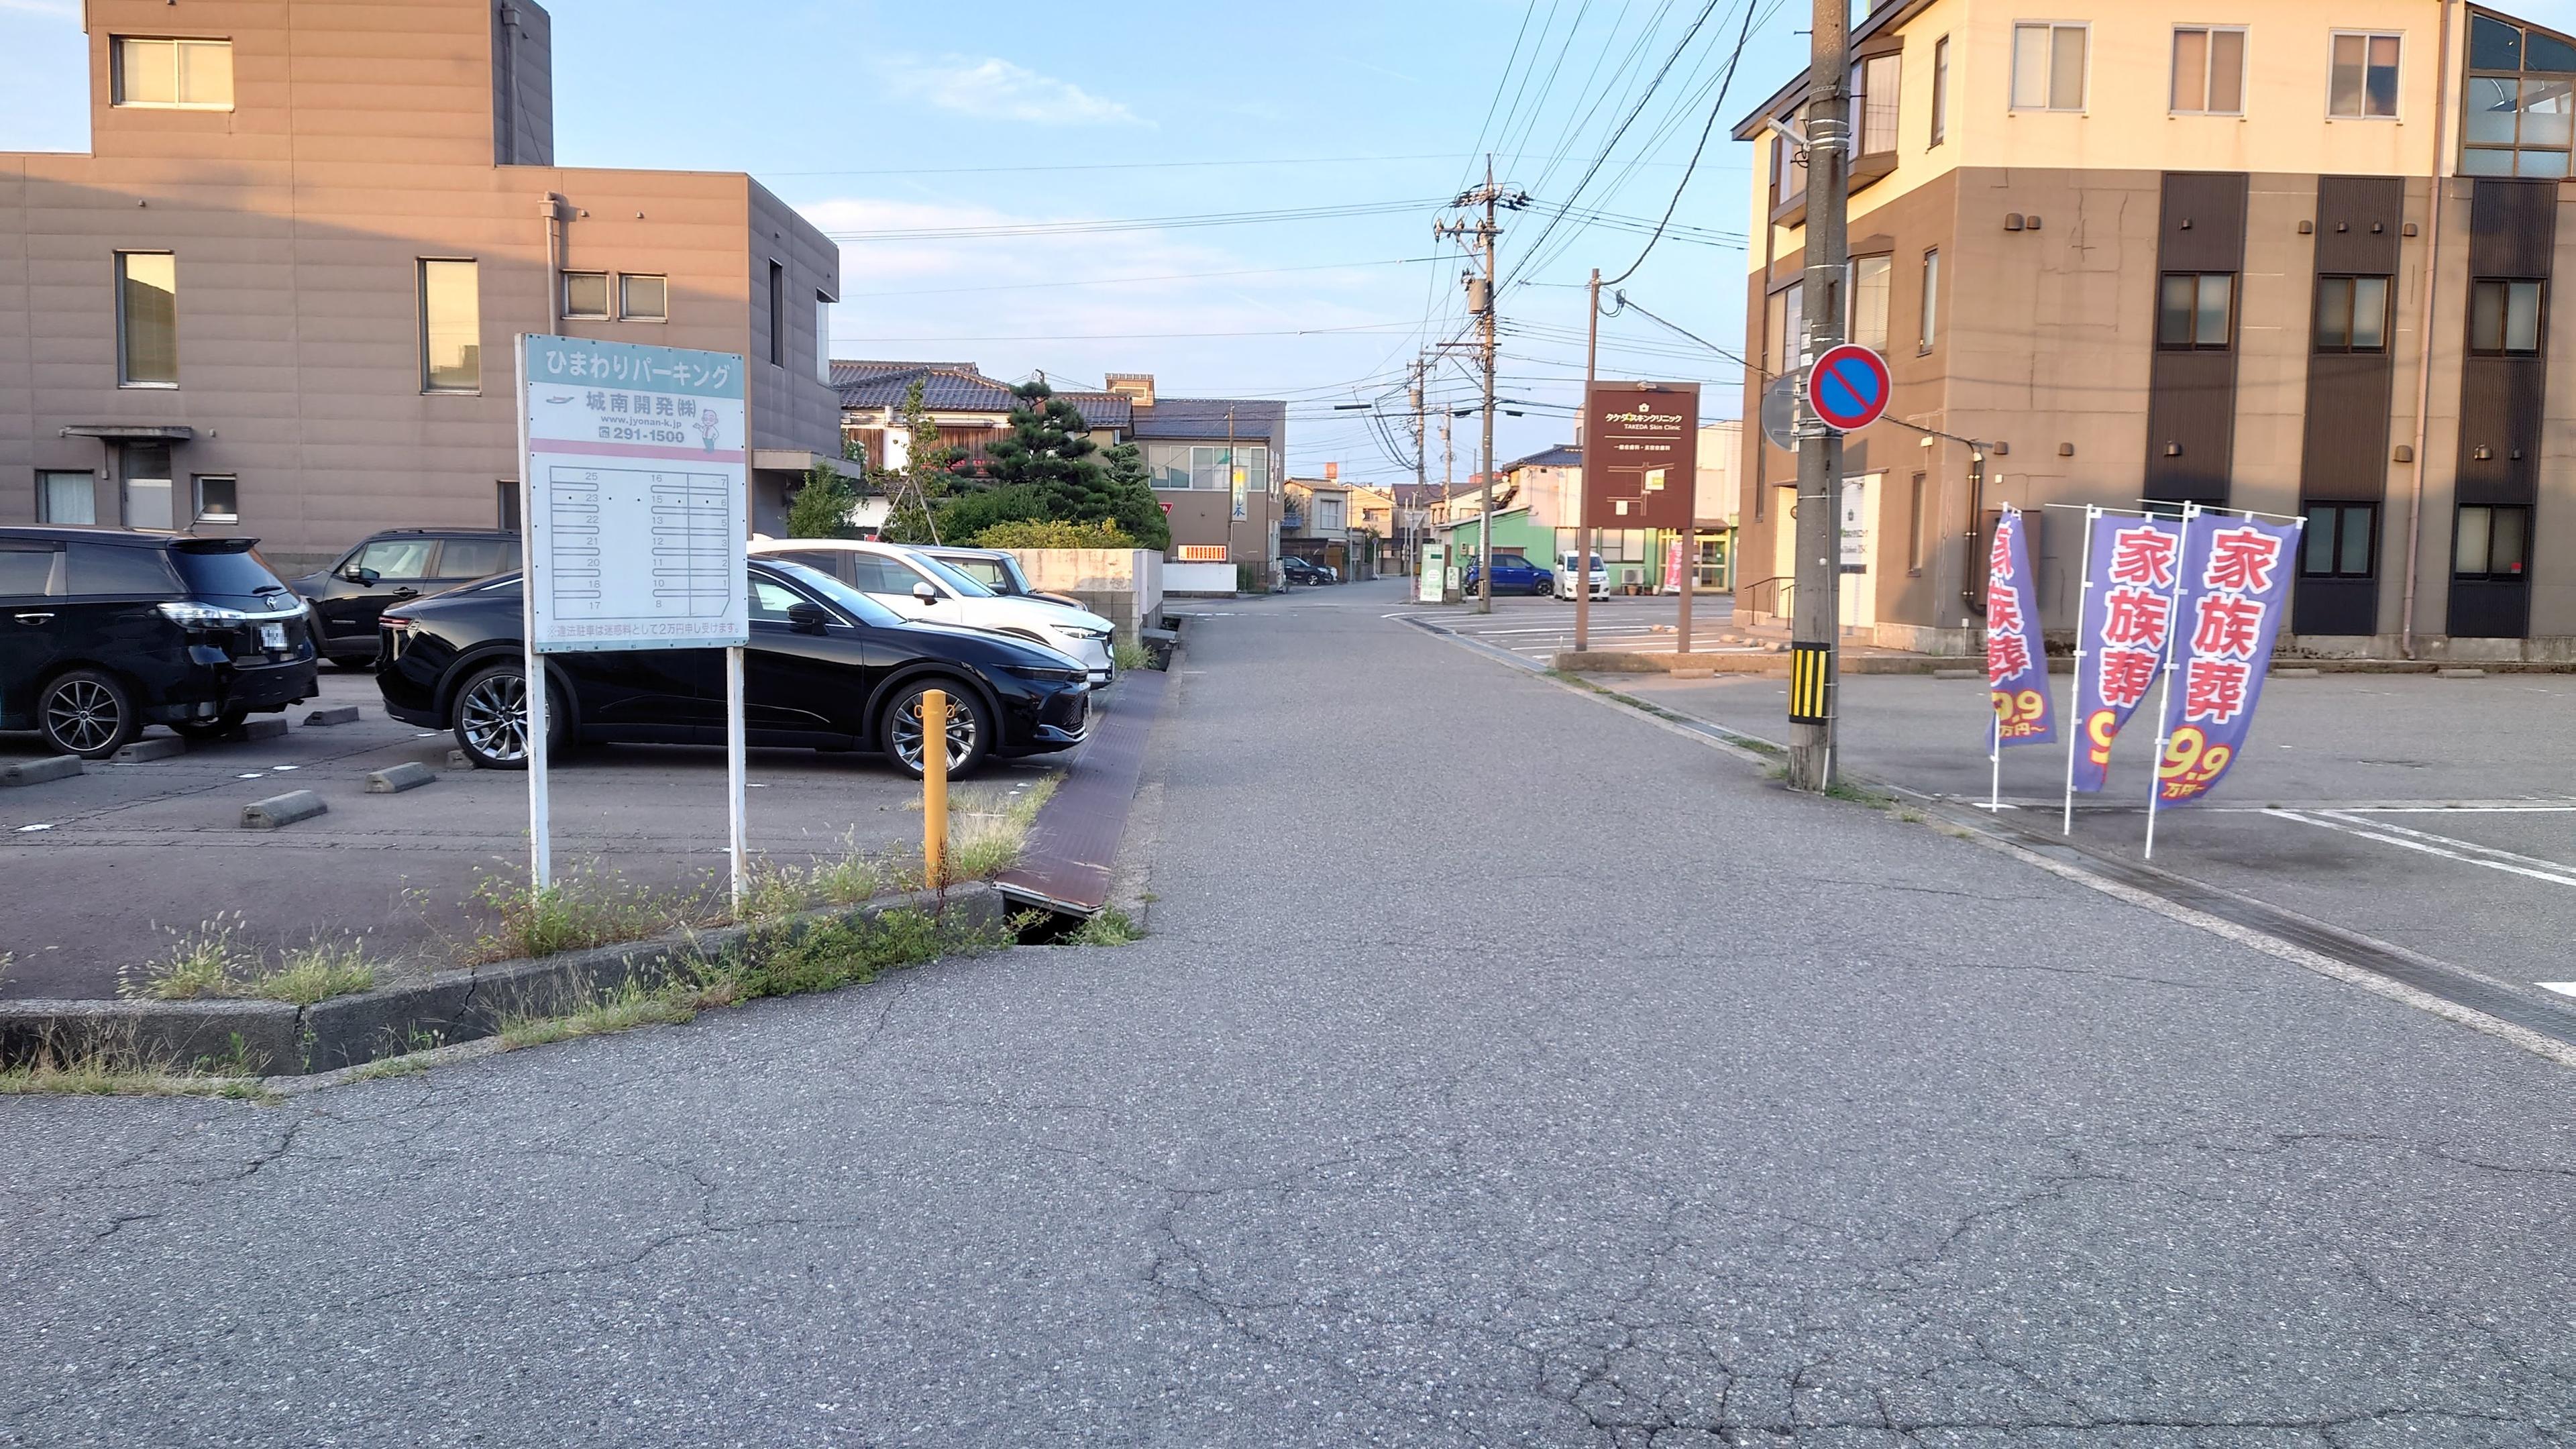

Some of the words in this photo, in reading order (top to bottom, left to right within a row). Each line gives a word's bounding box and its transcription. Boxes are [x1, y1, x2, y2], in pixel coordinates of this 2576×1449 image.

[547, 350, 730, 389] ひまわりパーキング
[1605, 413, 1682, 422] タケダスキンクリニック
[601, 416, 682, 429] www.jyonan-k.jp
[613, 427, 684, 443] 291-1500
[585, 472, 598, 481] 25
[651, 474, 663, 482] 16
[720, 478, 727, 487] 7
[586, 493, 598, 502] 23
[651, 495, 663, 504] 15
[720, 498, 727, 507] 6
[586, 515, 599, 524] 22
[652, 516, 663, 525] 13
[721, 519, 727, 527] 5
[586, 537, 598, 545] 21
[653, 537, 664, 545] 12
[721, 539, 727, 547] 3
[587, 558, 600, 567] 20
[653, 558, 663, 566] 11
[722, 559, 728, 568] 2
[588, 580, 601, 588] 18
[653, 579, 665, 588] 10
[590, 601, 601, 610] 17
[655, 600, 662, 608] 8
[2099, 525, 2178, 708] 家族葬
[2185, 527, 2282, 724] 家族葬
[2158, 725, 2232, 782] 9.9
